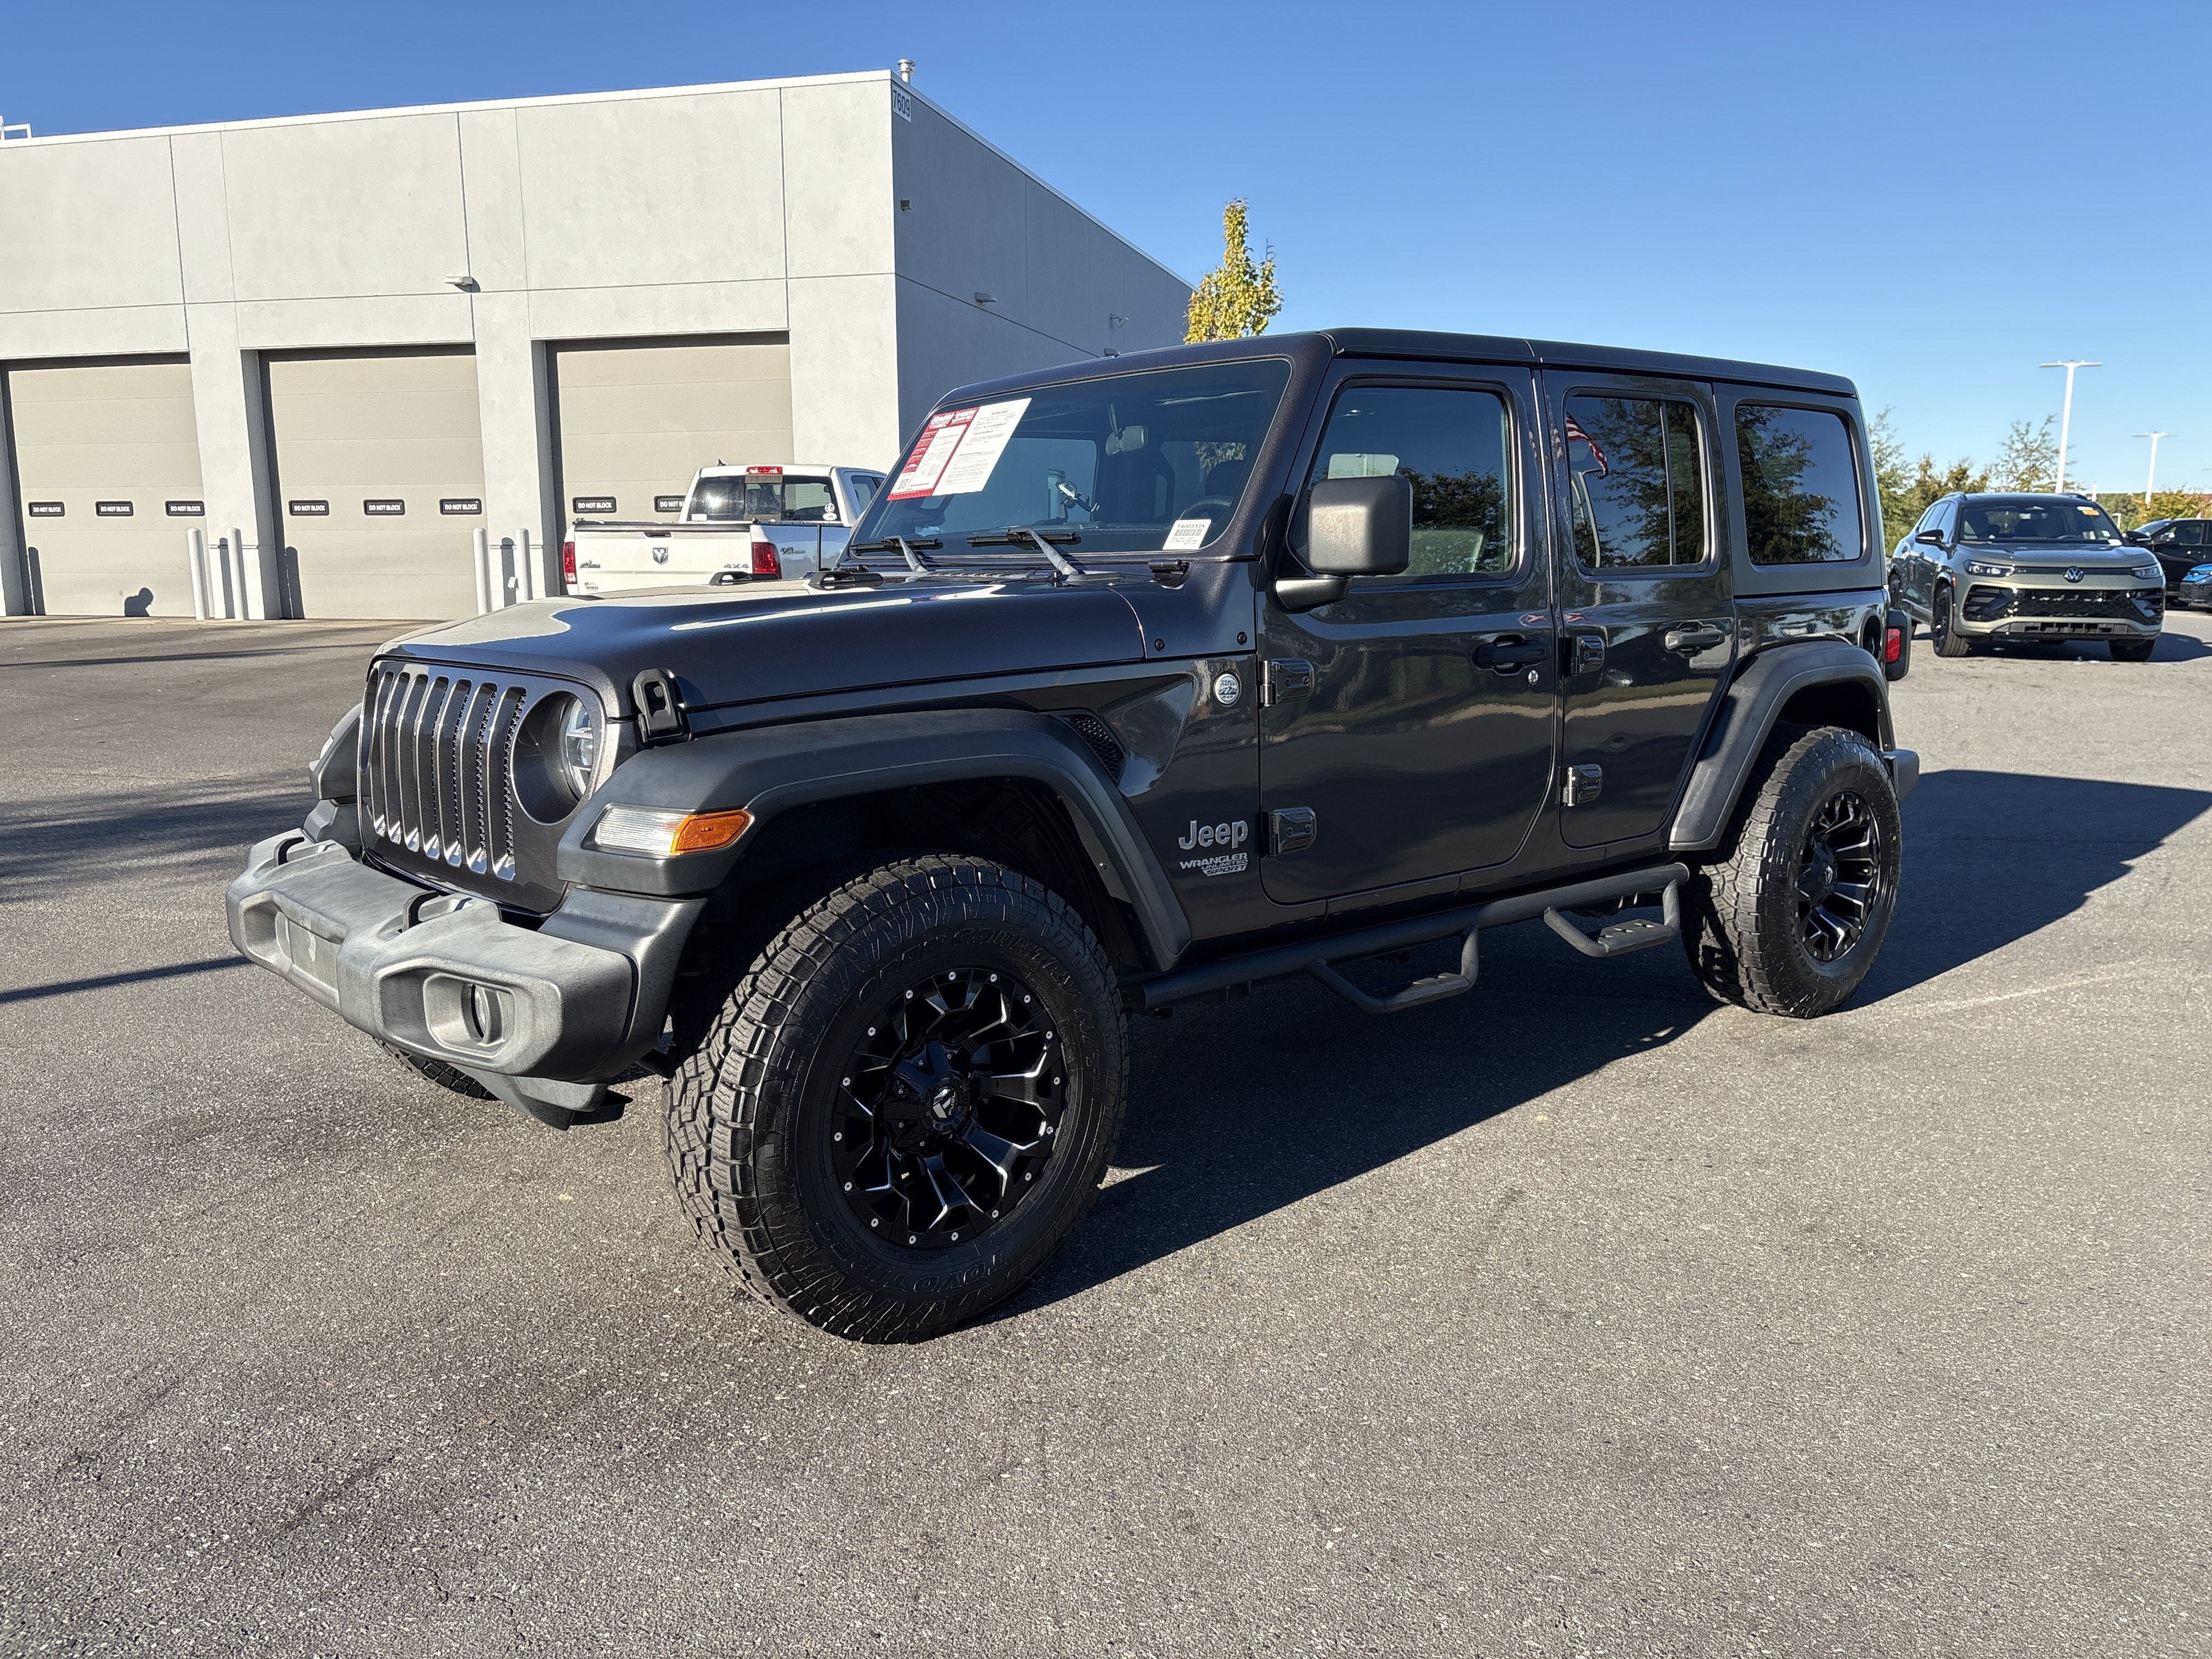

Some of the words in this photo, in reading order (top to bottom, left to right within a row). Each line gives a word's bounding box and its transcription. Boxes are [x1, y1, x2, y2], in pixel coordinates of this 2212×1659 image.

[893, 89, 910, 117] 7609
[1178, 820, 1248, 850] Jeep
[1180, 852, 1248, 870] WRANGLER
[1201, 859, 1248, 870] UNLIMITED
[1205, 865, 1246, 874] SPORT
[951, 927, 1082, 995] COUNTRY
[947, 1091, 956, 1116] FUEL
[912, 1250, 1006, 1293] TOYO
